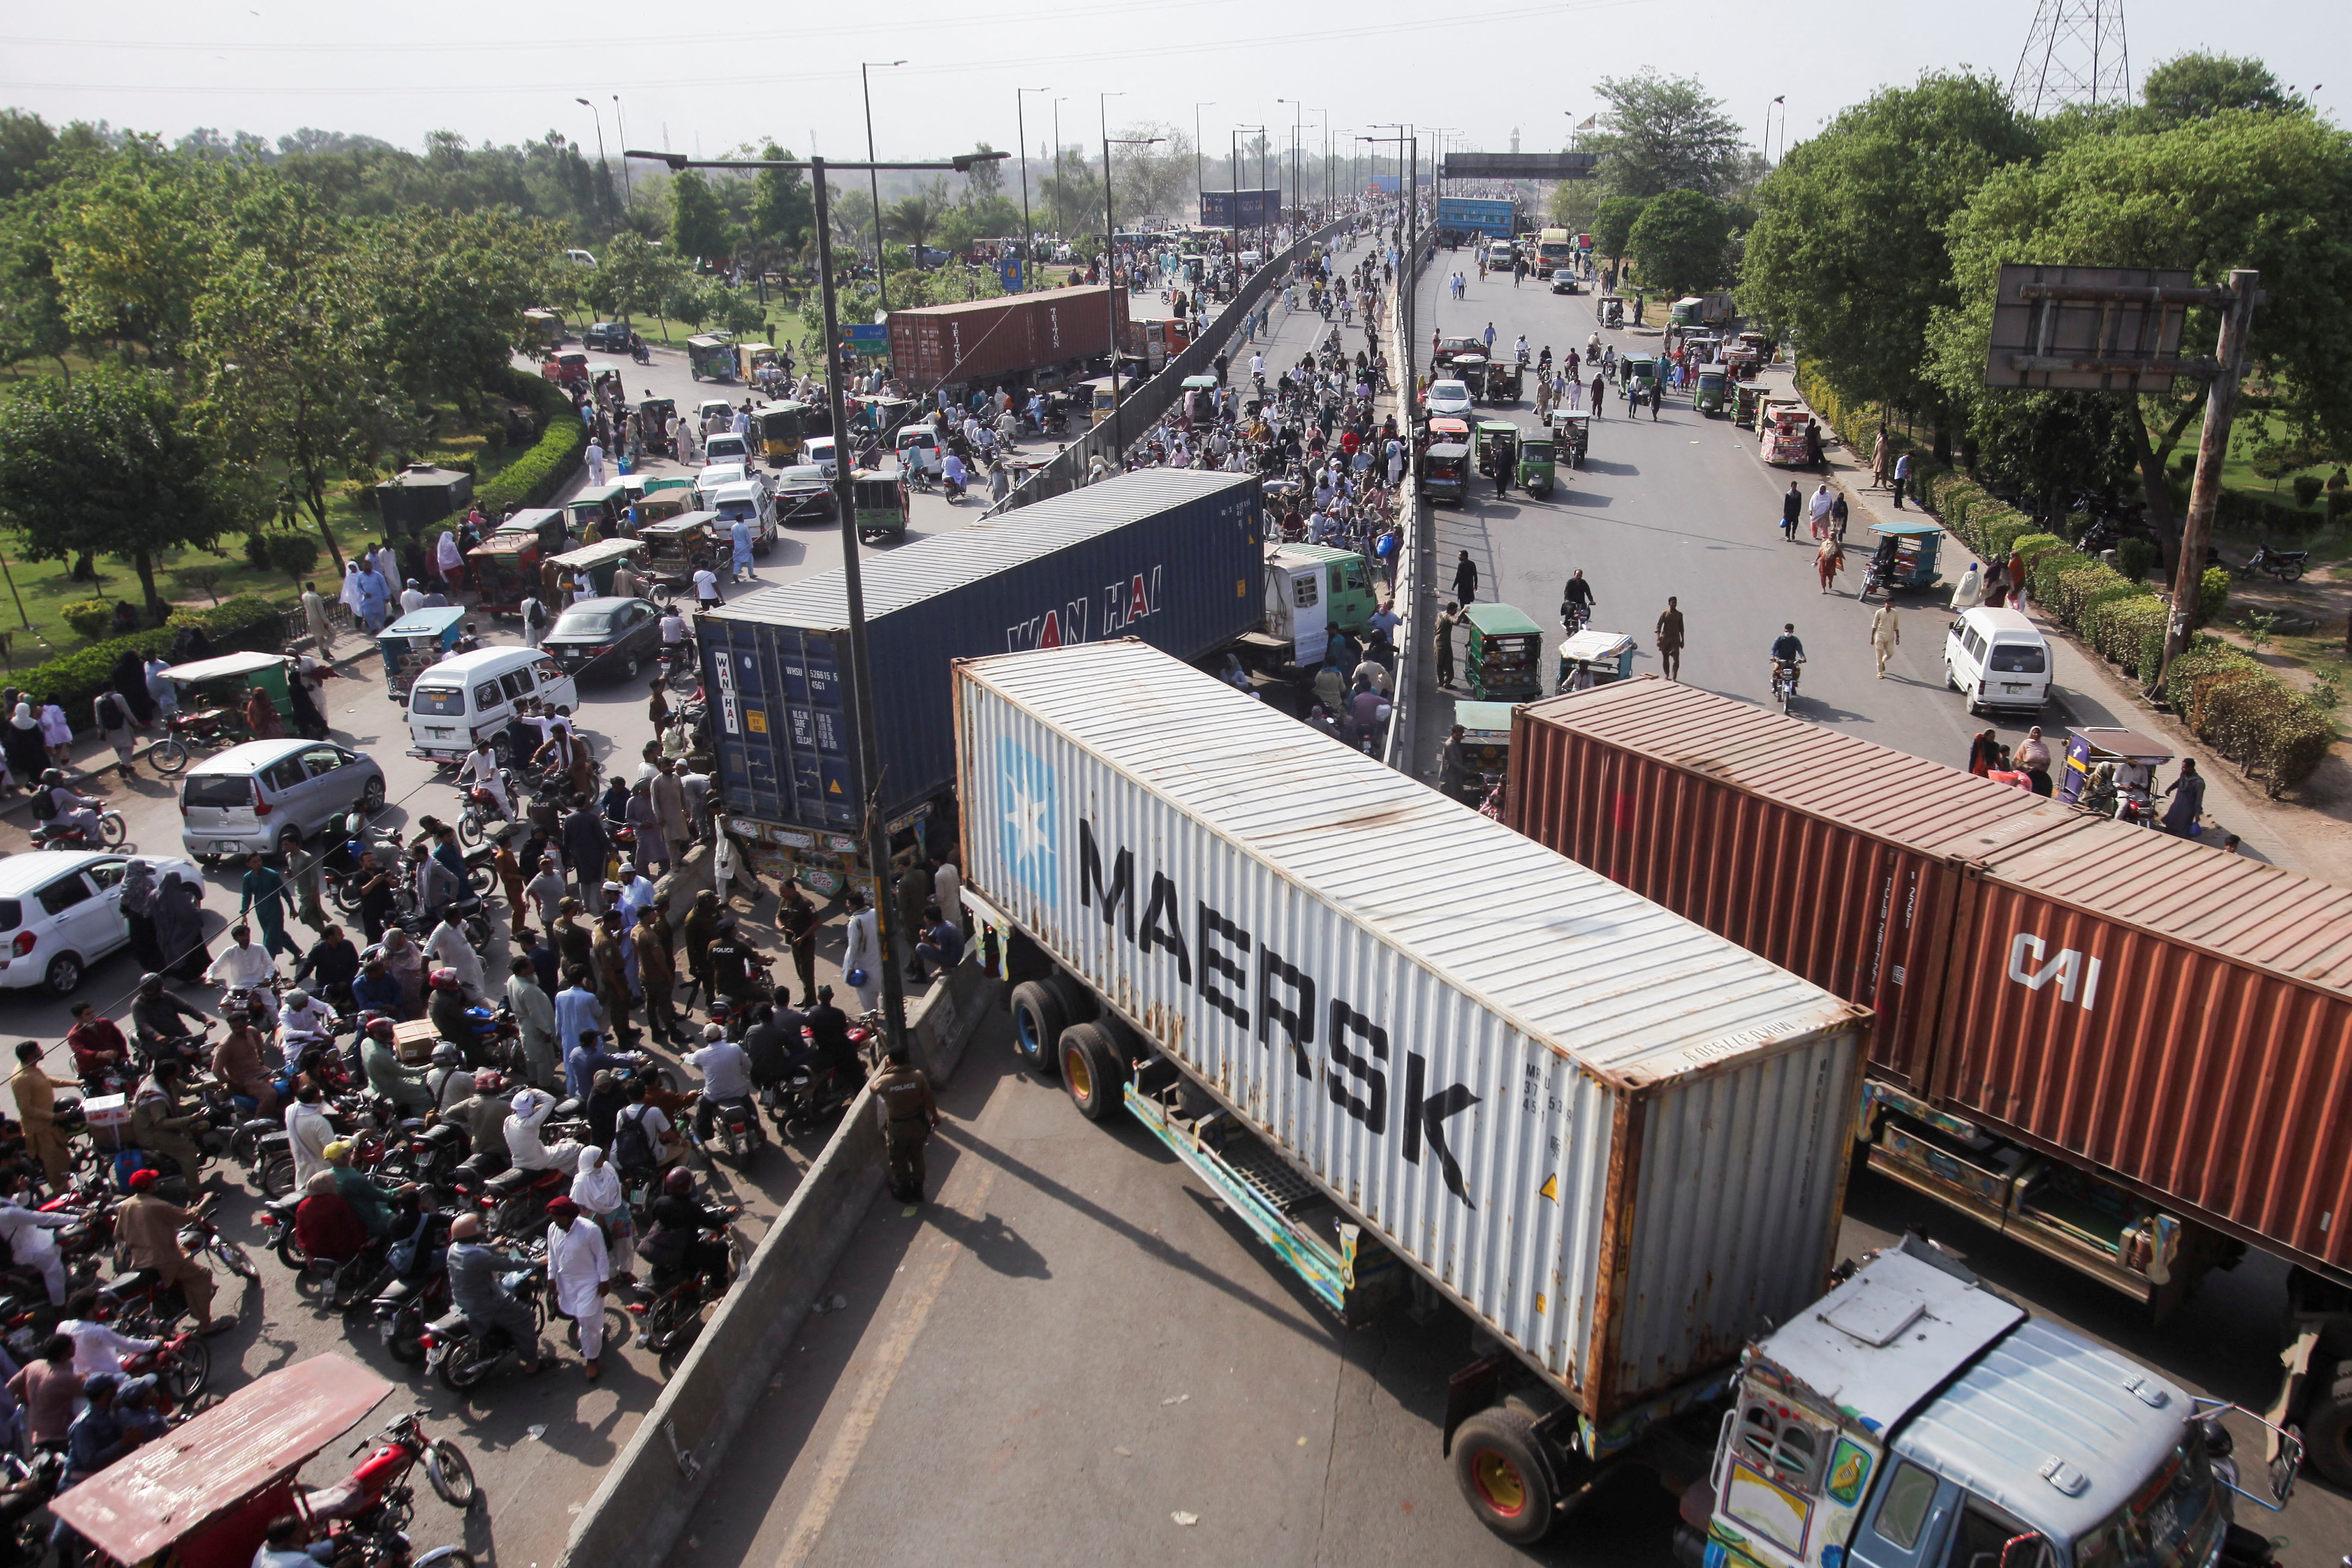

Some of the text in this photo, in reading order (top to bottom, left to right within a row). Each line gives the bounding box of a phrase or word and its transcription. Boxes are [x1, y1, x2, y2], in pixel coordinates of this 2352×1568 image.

[952, 322, 961, 365] TRITON
[1051, 307, 1059, 348] TRITON
[1007, 564, 1161, 653] WAN HAI
[717, 657, 734, 728] WAN HAI
[786, 666, 838, 681] WHSU 526615 5
[811, 681, 825, 690] 45G1
[2008, 933, 2101, 1011] CAI
[1080, 818, 1483, 1210] MAERSK
[889, 1082, 916, 1091] POLICE
